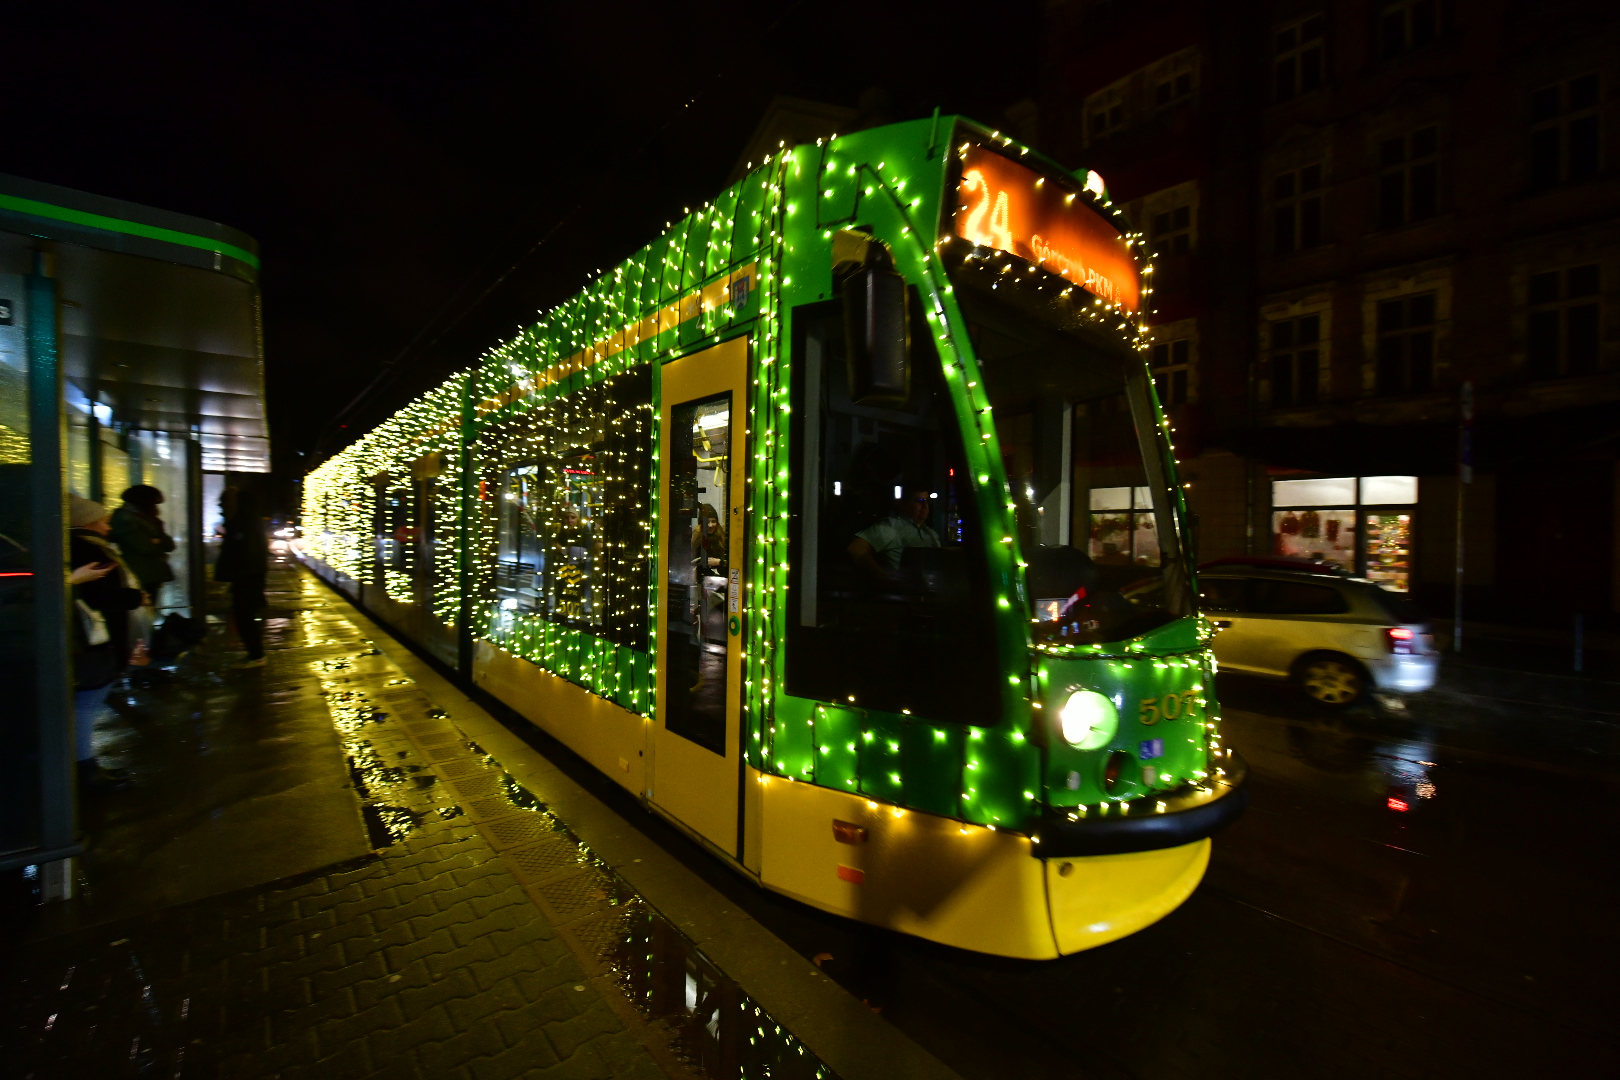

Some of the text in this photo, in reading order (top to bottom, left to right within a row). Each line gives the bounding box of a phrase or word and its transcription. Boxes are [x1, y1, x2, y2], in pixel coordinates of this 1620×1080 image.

[963, 169, 1013, 252] 24
[1088, 268, 1113, 301] PKM
[1139, 689, 1198, 726] 507
